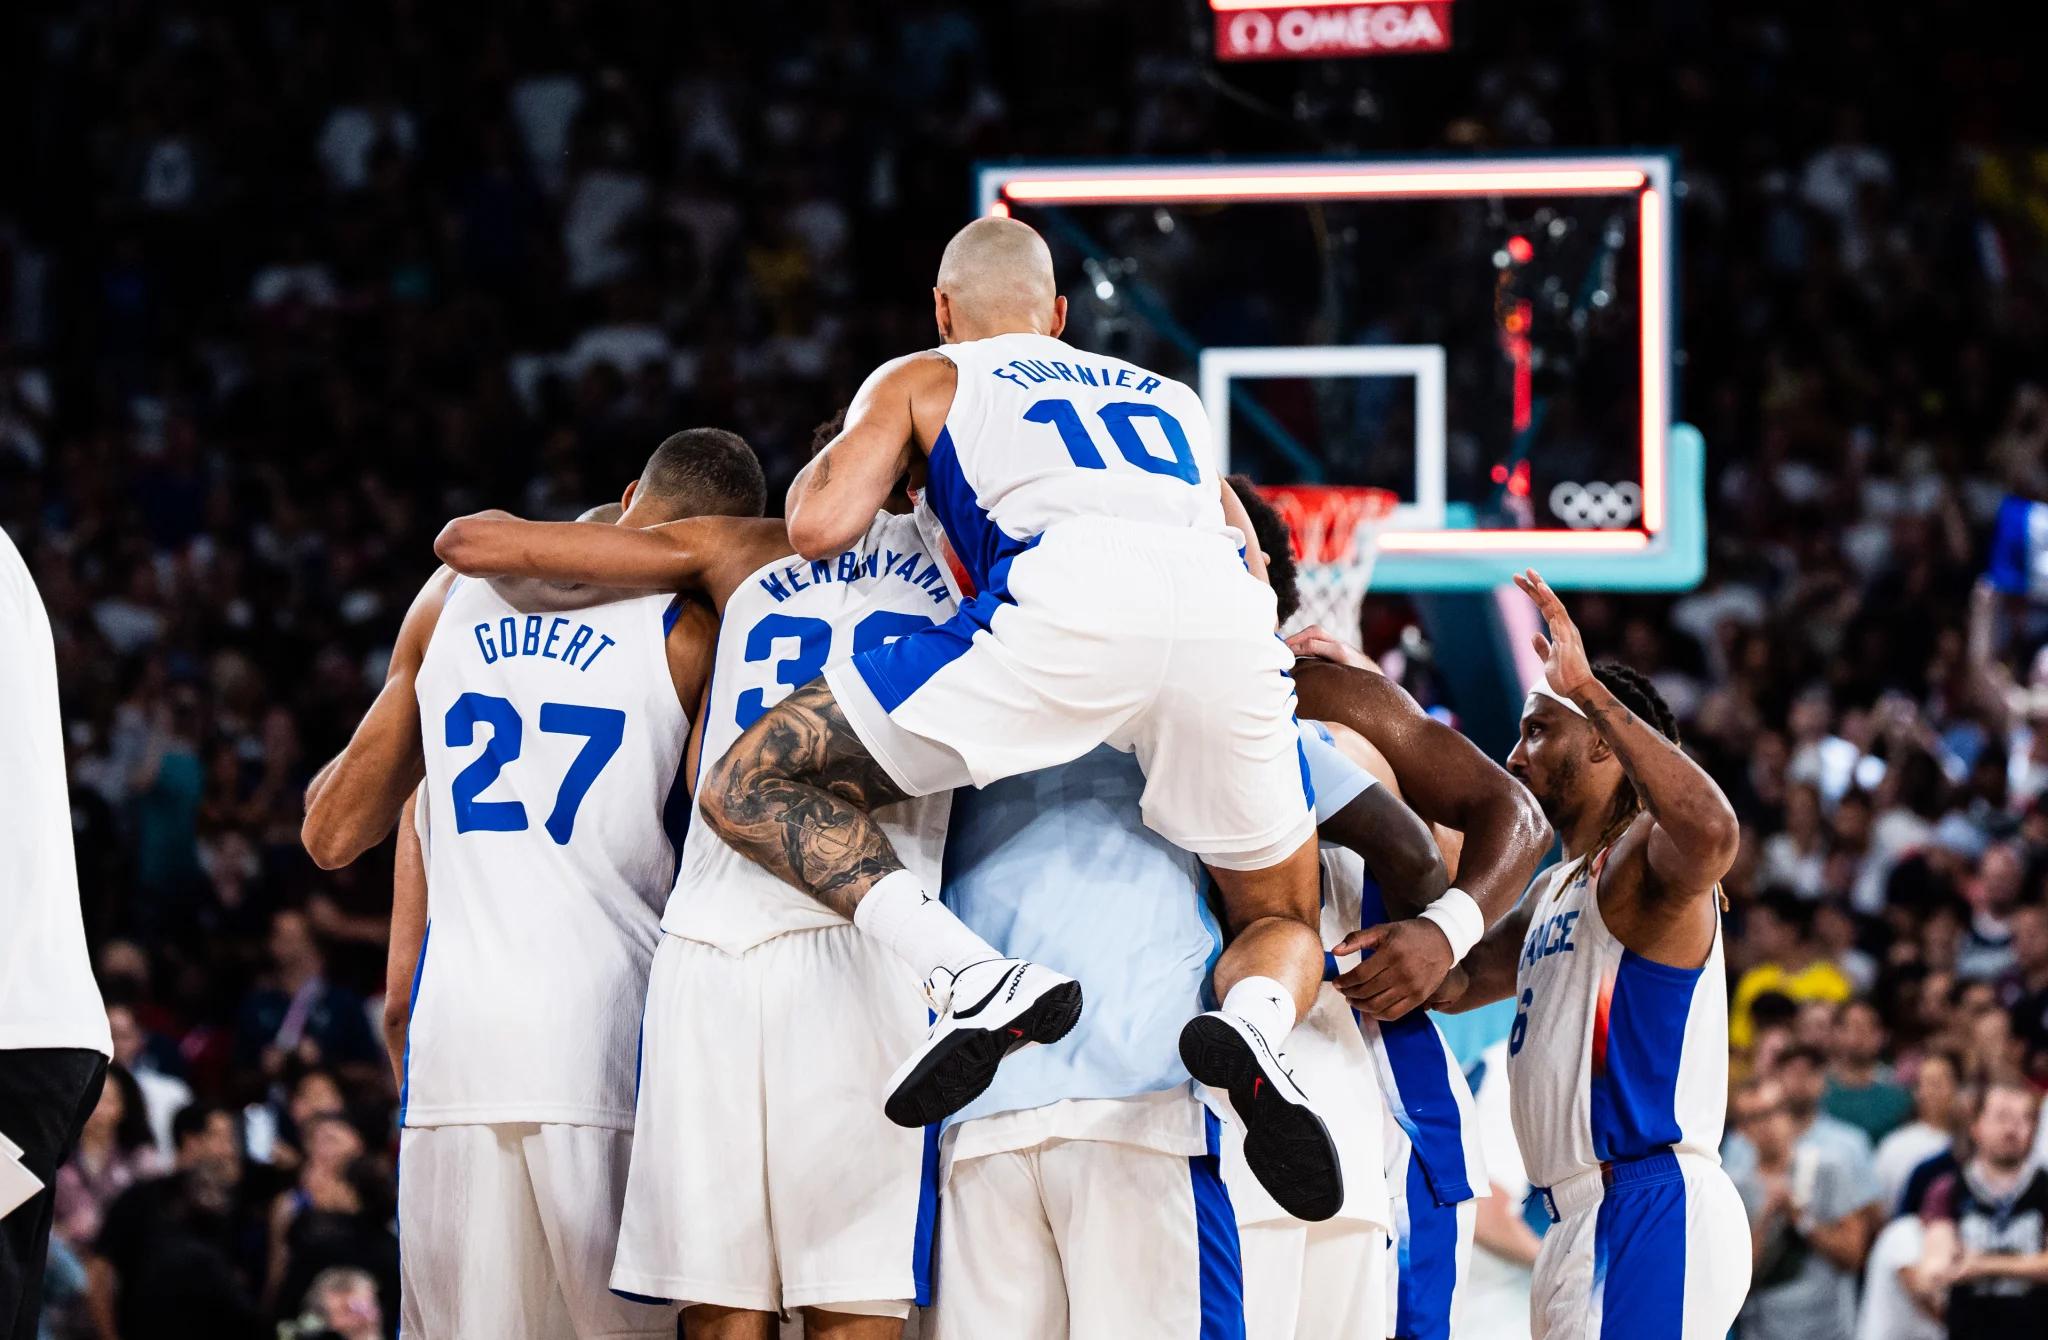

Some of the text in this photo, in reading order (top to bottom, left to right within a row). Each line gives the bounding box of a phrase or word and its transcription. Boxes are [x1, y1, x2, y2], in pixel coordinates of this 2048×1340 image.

[1276, 4, 1443, 52] OMEGA
[993, 359, 1161, 395] FOURNIER
[1022, 398, 1201, 486] 10
[474, 615, 616, 672] GOBERT
[445, 692, 626, 846] 27
[1519, 910, 1580, 971] ANCE
